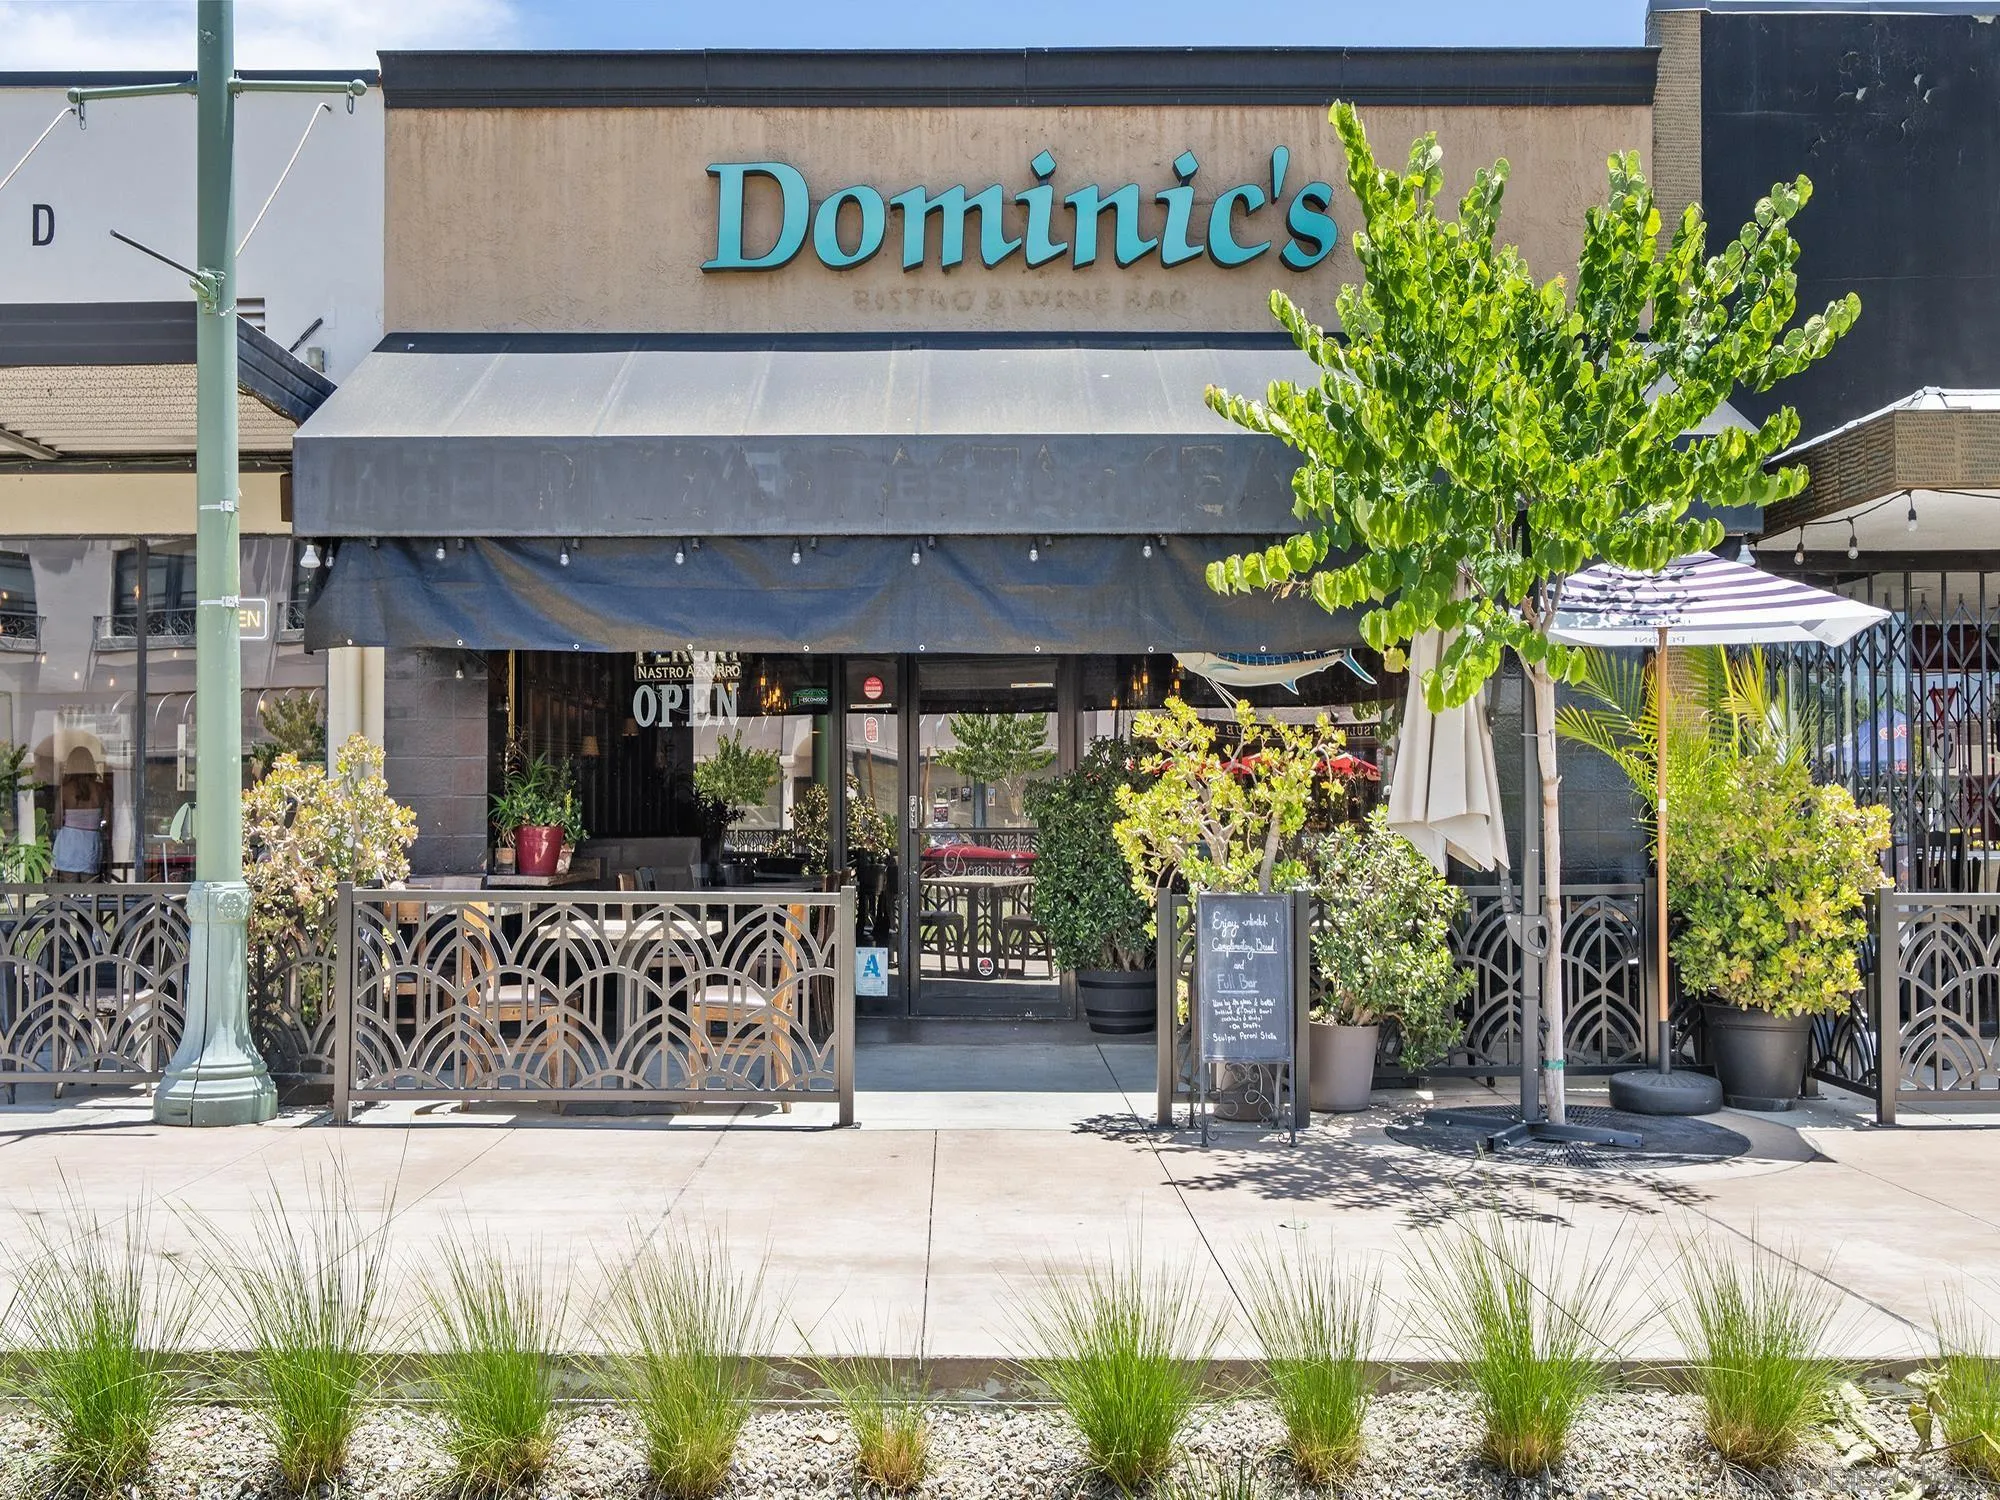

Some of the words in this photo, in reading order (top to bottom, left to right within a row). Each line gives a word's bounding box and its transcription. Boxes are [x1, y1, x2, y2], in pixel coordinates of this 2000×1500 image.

[701, 145, 1338, 273] Dominic's
[32, 204, 55, 246] D
[239, 610, 260, 627] EN
[638, 666, 684, 679] NASTRO
[633, 684, 740, 728] OPEN
[1212, 911, 1239, 938] Enjoy
[863, 954, 881, 977] A
[1233, 959, 1245, 970] and
[1217, 973, 1236, 990] Full
[1238, 973, 1258, 990] Bar
[1239, 1031, 1258, 1040] Peroni
